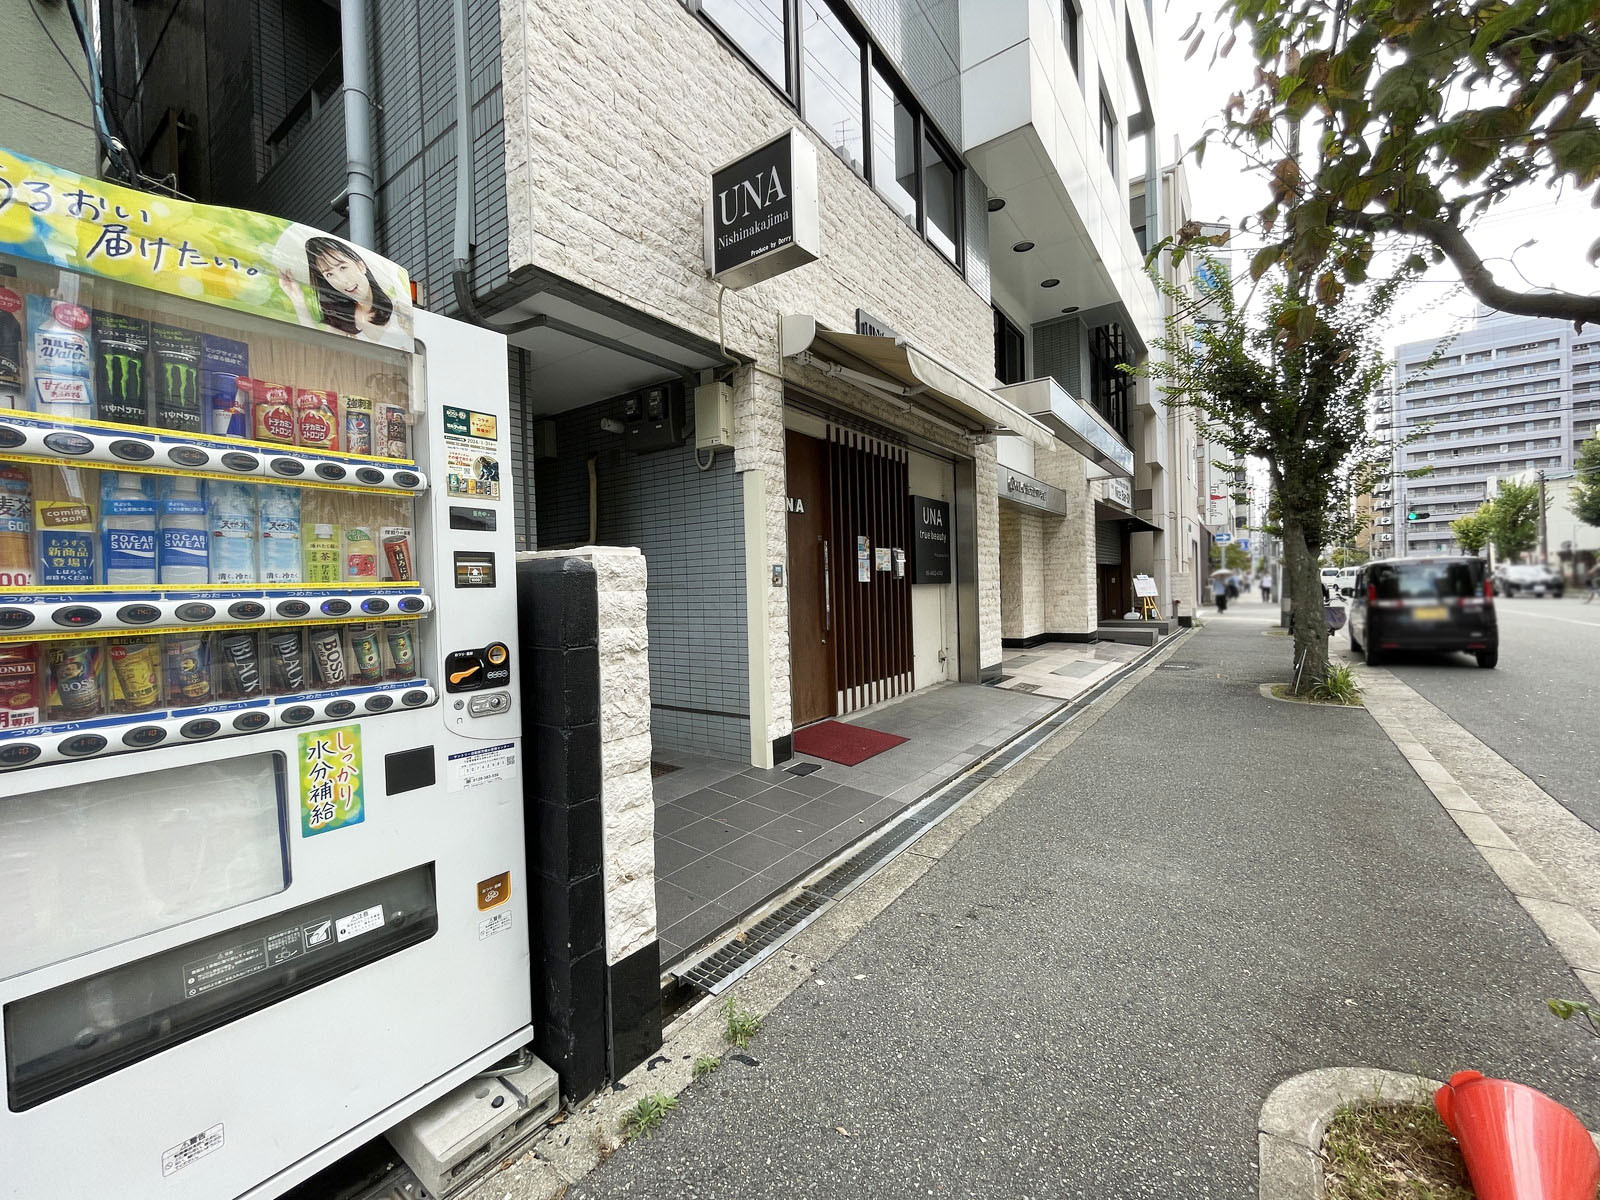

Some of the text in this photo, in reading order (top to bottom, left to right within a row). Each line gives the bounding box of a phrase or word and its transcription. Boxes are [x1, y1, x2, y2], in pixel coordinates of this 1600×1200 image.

[718, 165, 787, 226] UNA
[718, 209, 789, 250] Nishinakajima
[86, 224, 259, 275] 届けたい。
[750, 244, 769, 257] Produce
[770, 241, 777, 251] by
[42, 337, 84, 352] カルピス
[40, 346, 85, 360] Water
[0, 495, 31, 519] 麦茶
[47, 508, 88, 517] coming
[922, 506, 943, 527] UNA
[8, 520, 30, 532] 600
[221, 520, 250, 530] 天然水
[268, 521, 299, 531] 天然水
[919, 529, 947, 543] true beauty
[48, 546, 89, 557] 新商品
[111, 541, 154, 550] SWEAT
[164, 540, 206, 549] SWEAT
[320, 552, 330, 561] 茶
[230, 642, 261, 692] BLACK
[279, 641, 304, 688] BLACK
[323, 638, 344, 681] BOSS
[61, 677, 95, 692] BOSS
[337, 731, 358, 808] しっかり
[307, 740, 337, 825] 水分補給
